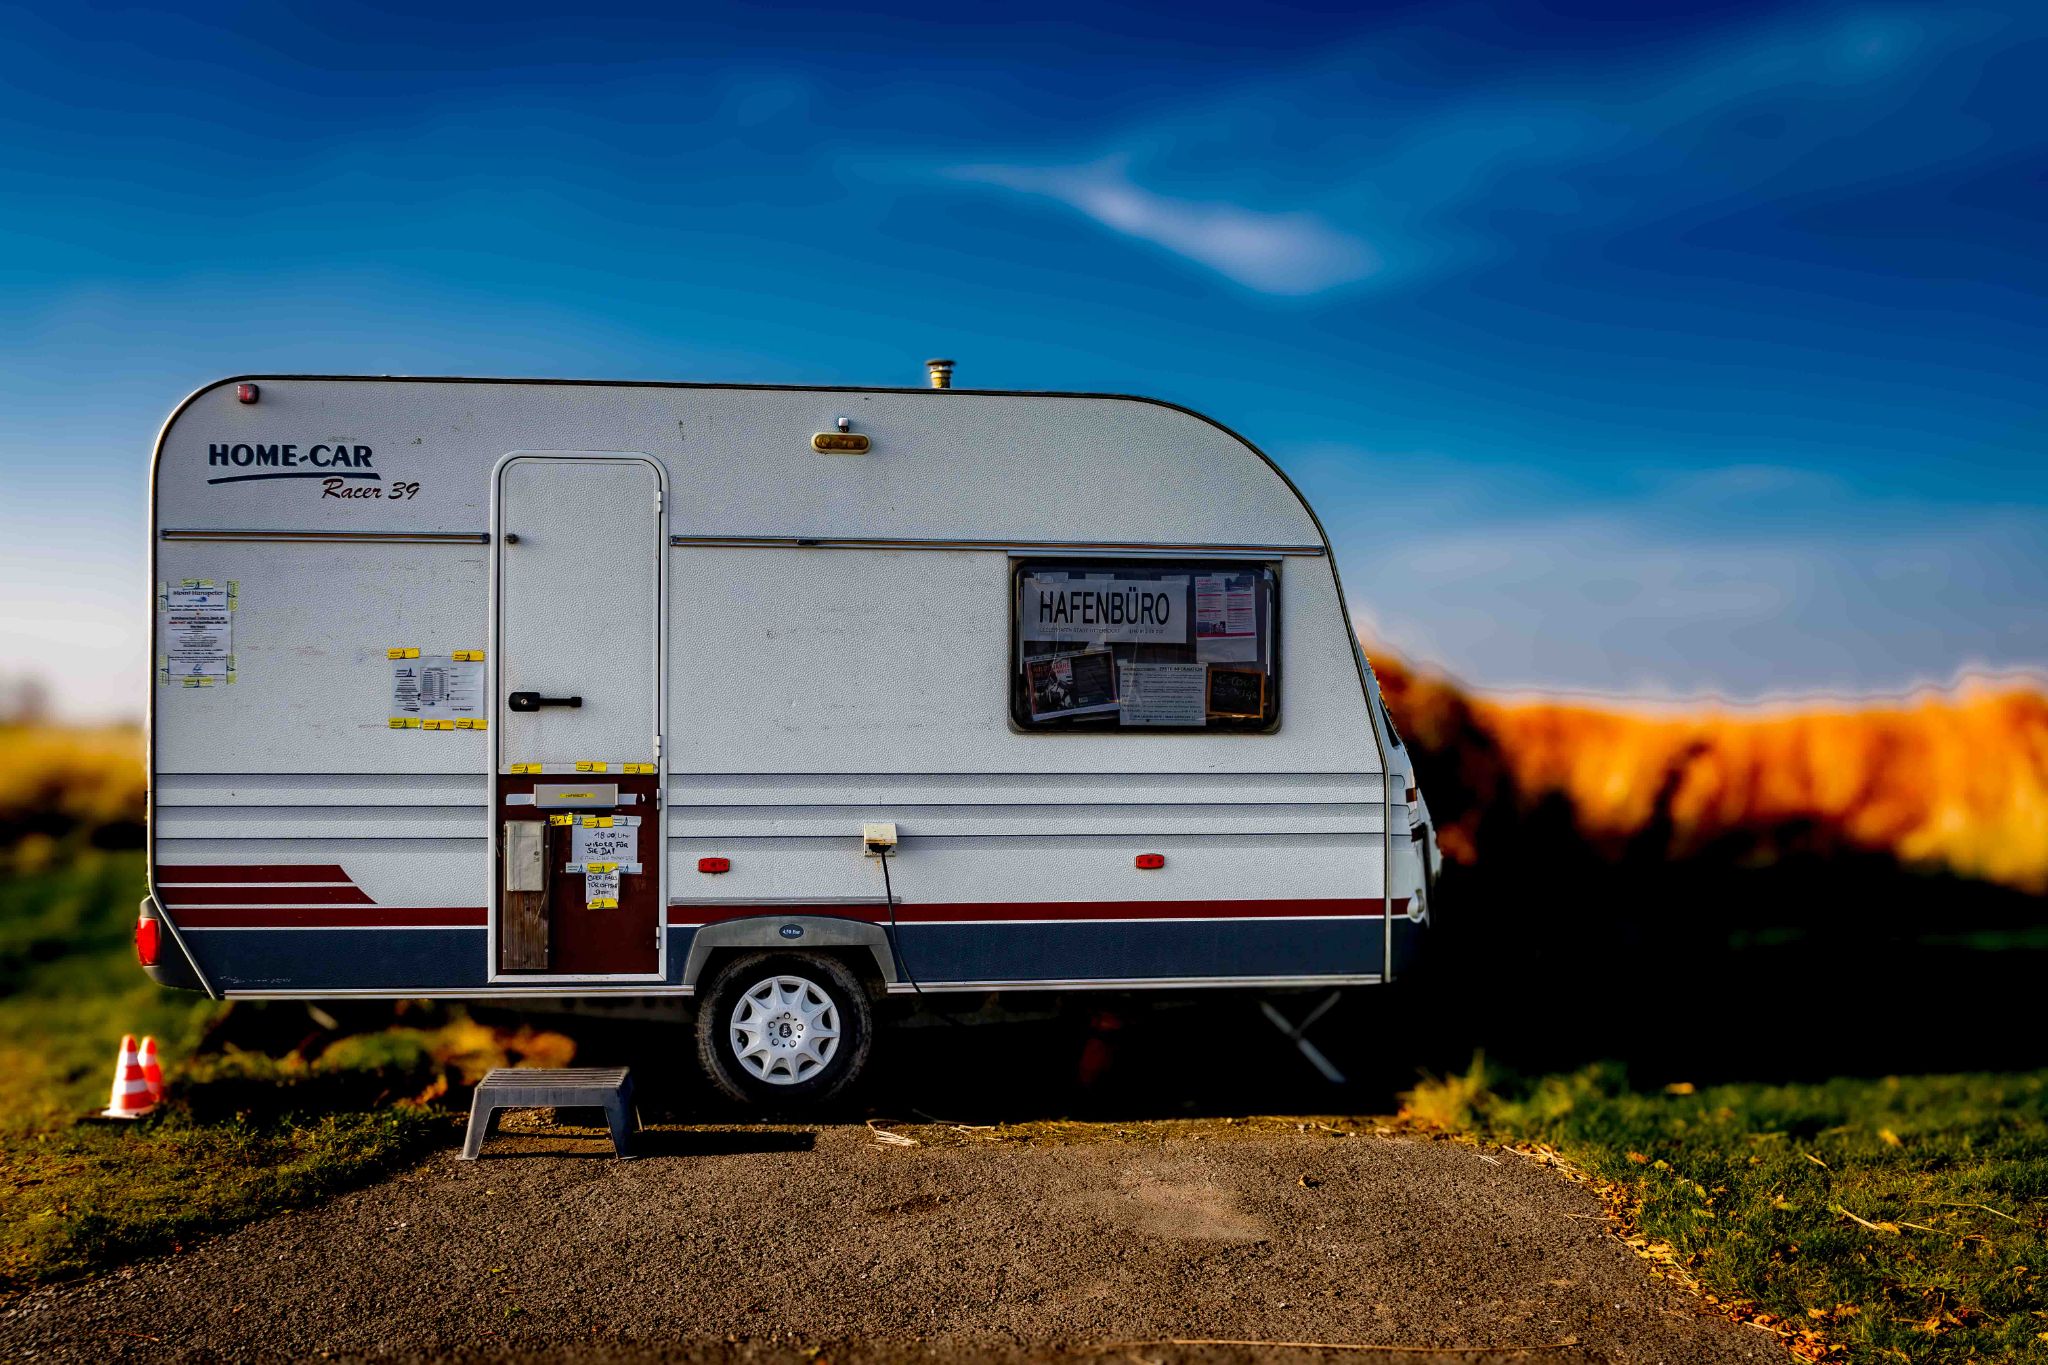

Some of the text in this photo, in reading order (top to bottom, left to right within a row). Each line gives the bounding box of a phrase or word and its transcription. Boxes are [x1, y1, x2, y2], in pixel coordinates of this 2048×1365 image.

[209, 444, 372, 468] HOME-CAR
[322, 478, 420, 500] Racer 39
[1039, 586, 1170, 626] HAFENBÜRO
